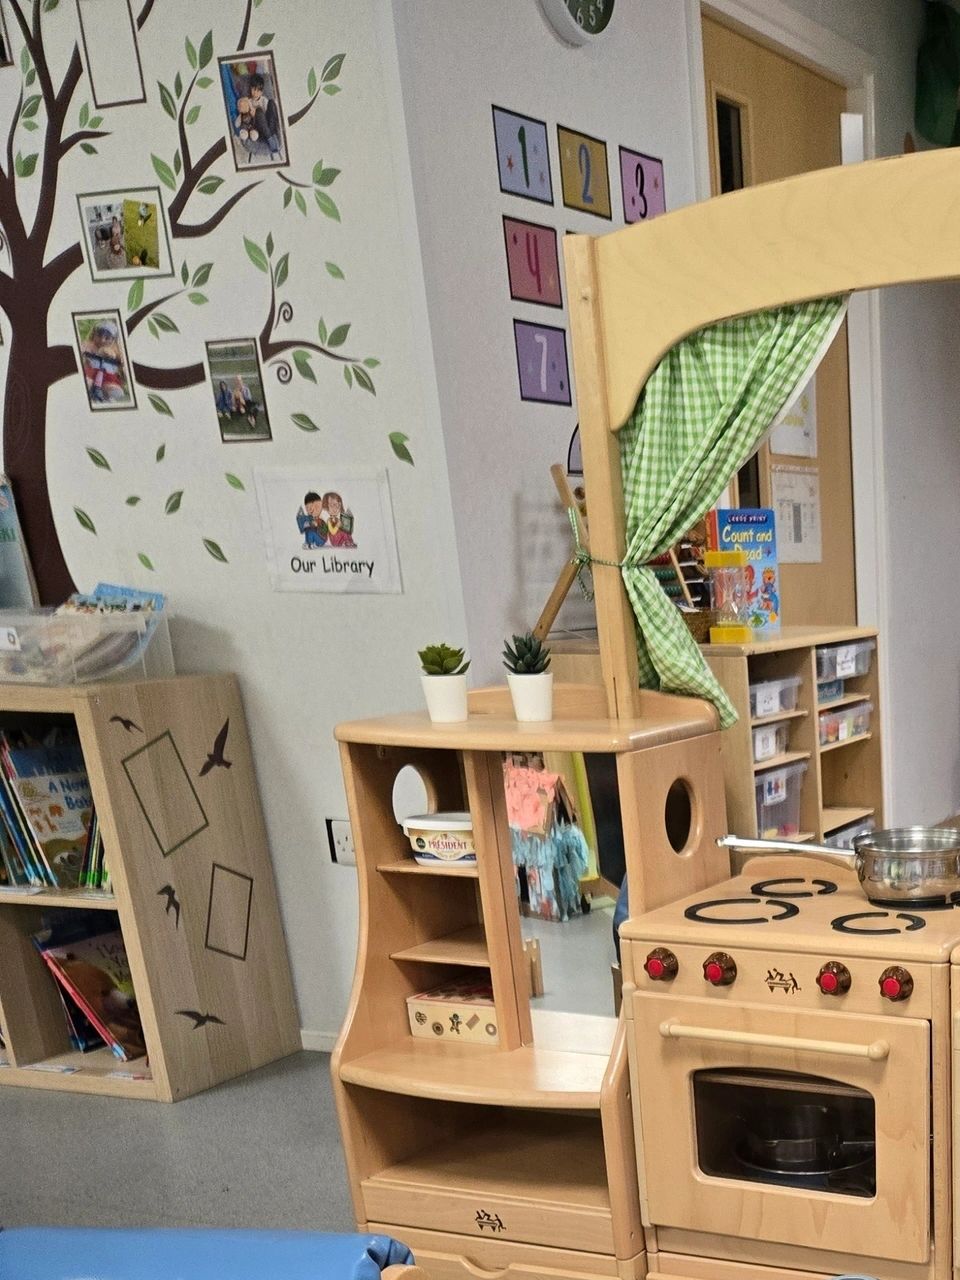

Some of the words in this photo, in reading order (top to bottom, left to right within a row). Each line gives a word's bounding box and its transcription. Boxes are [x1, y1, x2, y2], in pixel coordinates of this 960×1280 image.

[576, 7, 584, 27] 6
[589, 5, 596, 26] 5
[517, 125, 530, 189] 1
[578, 143, 593, 204] 2
[635, 162, 648, 219] 3
[525, 231, 542, 296] 4
[534, 334, 547, 393] 7
[722, 525, 754, 543] Count
[755, 530, 773, 542] and
[290, 556, 317, 574] Our
[322, 555, 375, 579] Library
